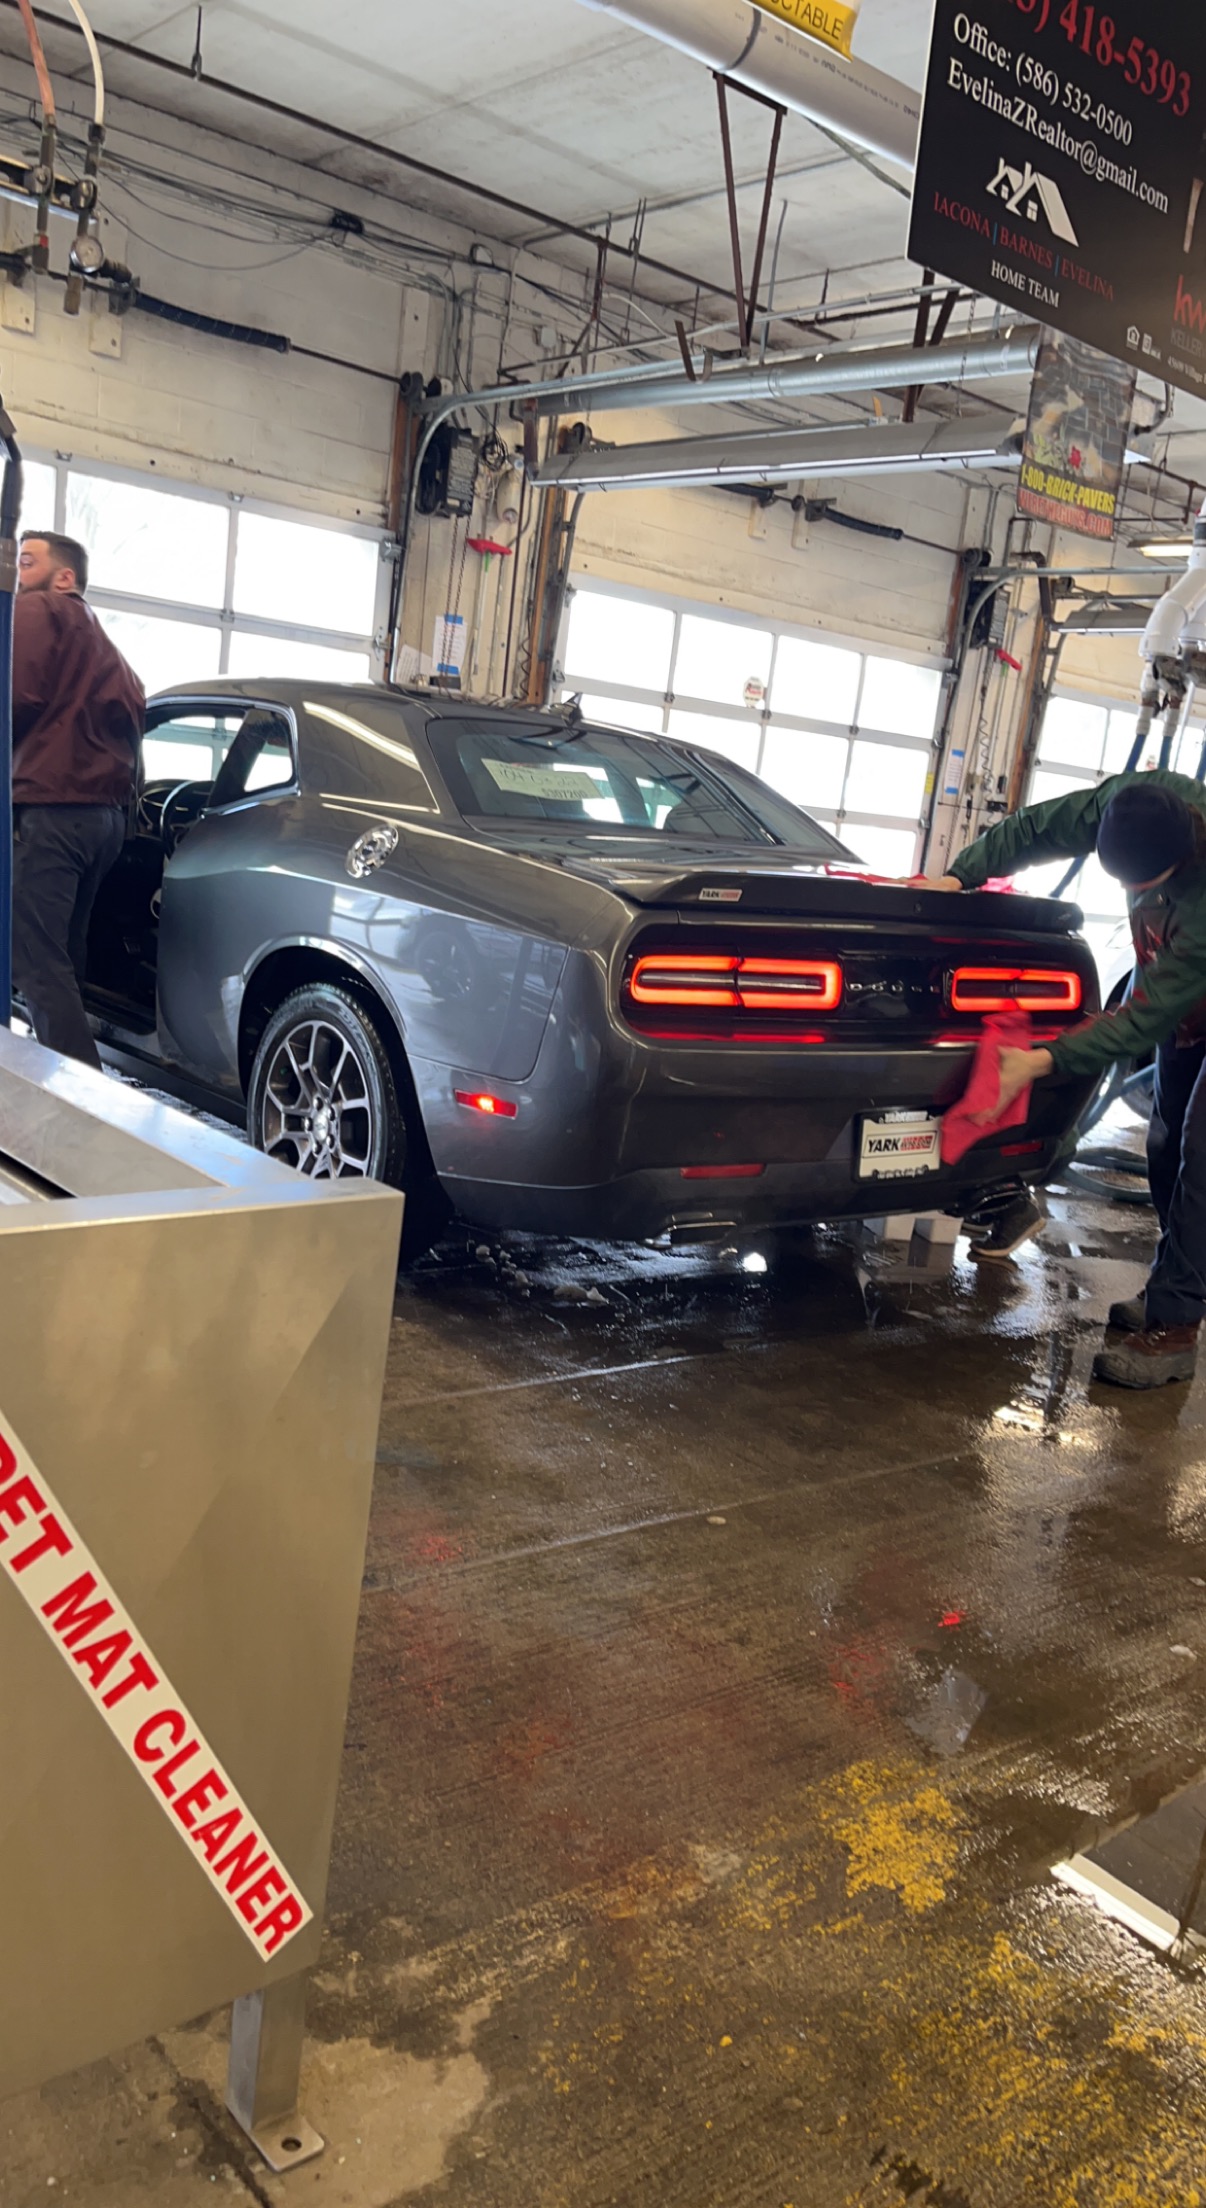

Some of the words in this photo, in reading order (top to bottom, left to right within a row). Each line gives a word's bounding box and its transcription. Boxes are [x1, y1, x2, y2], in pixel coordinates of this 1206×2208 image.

[771, 0, 844, 40] CTABLE
[1059, 0, 1191, 117] 418-5393
[947, 56, 1169, 215] EvelinaZRealtor@gmail.com
[953, 12, 1012, 72] Office:
[1016, 52, 1059, 106] (586)
[1062, 82, 1132, 146] 532-0500
[934, 192, 991, 238] IACONA
[1000, 226, 1053, 269] BARNES
[1061, 258, 1114, 301] EVELINA
[991, 259, 1026, 293] HOME
[1028, 276, 1060, 308] TEAM
[868, 1137, 900, 1153] YARK
[0, 1432, 74, 1574] ET
[41, 1571, 159, 1710] MAT
[132, 1708, 304, 1955] CLEANER
